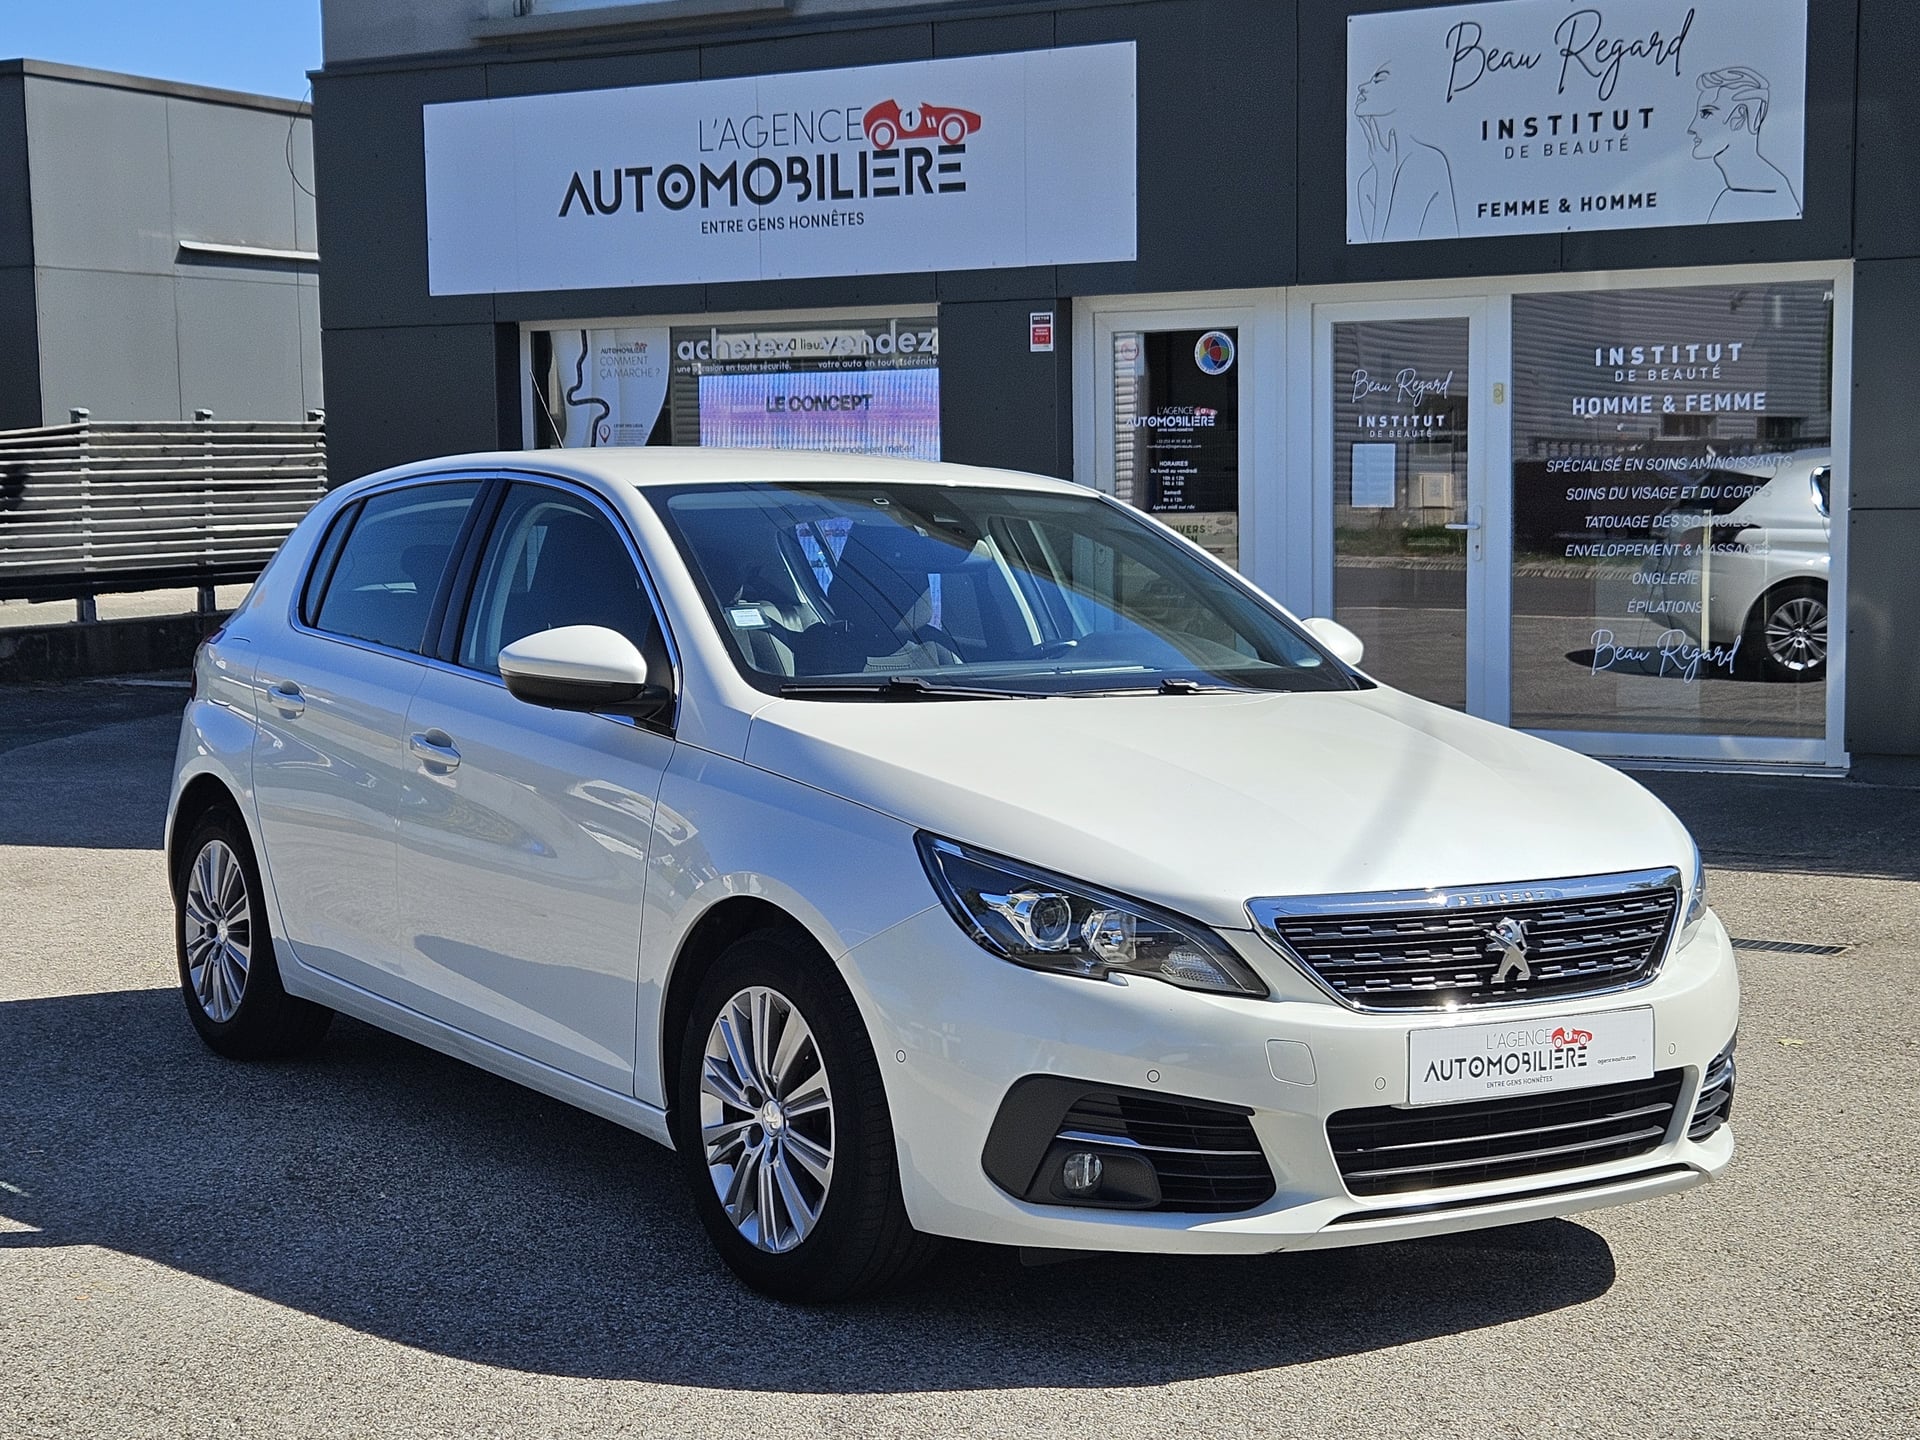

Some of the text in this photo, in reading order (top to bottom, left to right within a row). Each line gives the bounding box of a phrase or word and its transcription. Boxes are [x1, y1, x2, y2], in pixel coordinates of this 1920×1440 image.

[1446, 8, 1695, 102] Beau Regard
[905, 111, 913, 127] 1
[1481, 108, 1654, 141] INSTITUT
[699, 106, 863, 152] L'AGENCE
[1504, 135, 1630, 160] DE BEAUTÉ
[1477, 193, 1657, 219] FEMME & HOMME
[701, 209, 865, 235] ENTRE GENS HONNÊTES
[600, 356, 648, 366] COMMENT
[818, 361, 840, 369] votre
[842, 359, 862, 368] auto
[864, 359, 875, 367] en
[878, 358, 900, 367] tout
[1595, 343, 1742, 367] INSTITUT
[614, 368, 652, 377] MARCHE
[692, 364, 724, 374] ocasion
[737, 362, 758, 371] toute
[1615, 364, 1721, 382] DE BEAUTÉ
[1352, 368, 1452, 407] Beau Regard
[766, 394, 873, 413] LE CONCEPT
[1572, 392, 1767, 415] HOMME & FEMME
[1358, 415, 1445, 428] INSTITUT
[1369, 427, 1432, 438] DE BEAUTÉ
[1546, 455, 1625, 473] SPÉCIALISÉ
[1626, 457, 1644, 472] EN
[1645, 457, 1687, 471] SOINS
[1565, 488, 1606, 501] SOINS
[1609, 487, 1628, 500] DU
[1631, 487, 1678, 500] VISAGE
[1681, 486, 1698, 499] ET
[1700, 486, 1721, 499] DU
[1585, 515, 1649, 528] TATOUAGE
[1652, 515, 1679, 528] DES
[1565, 543, 1681, 557] ENVELOPPEMENT
[1683, 544, 1692, 556] &
[1632, 572, 1698, 585] ONGLERIE
[1627, 598, 1703, 613] ÉPILATIONS
[1590, 629, 1742, 684] Beau Regard
[1486, 1029, 1552, 1050] L'AGENCE
[1506, 1078, 1522, 1086] GENS
